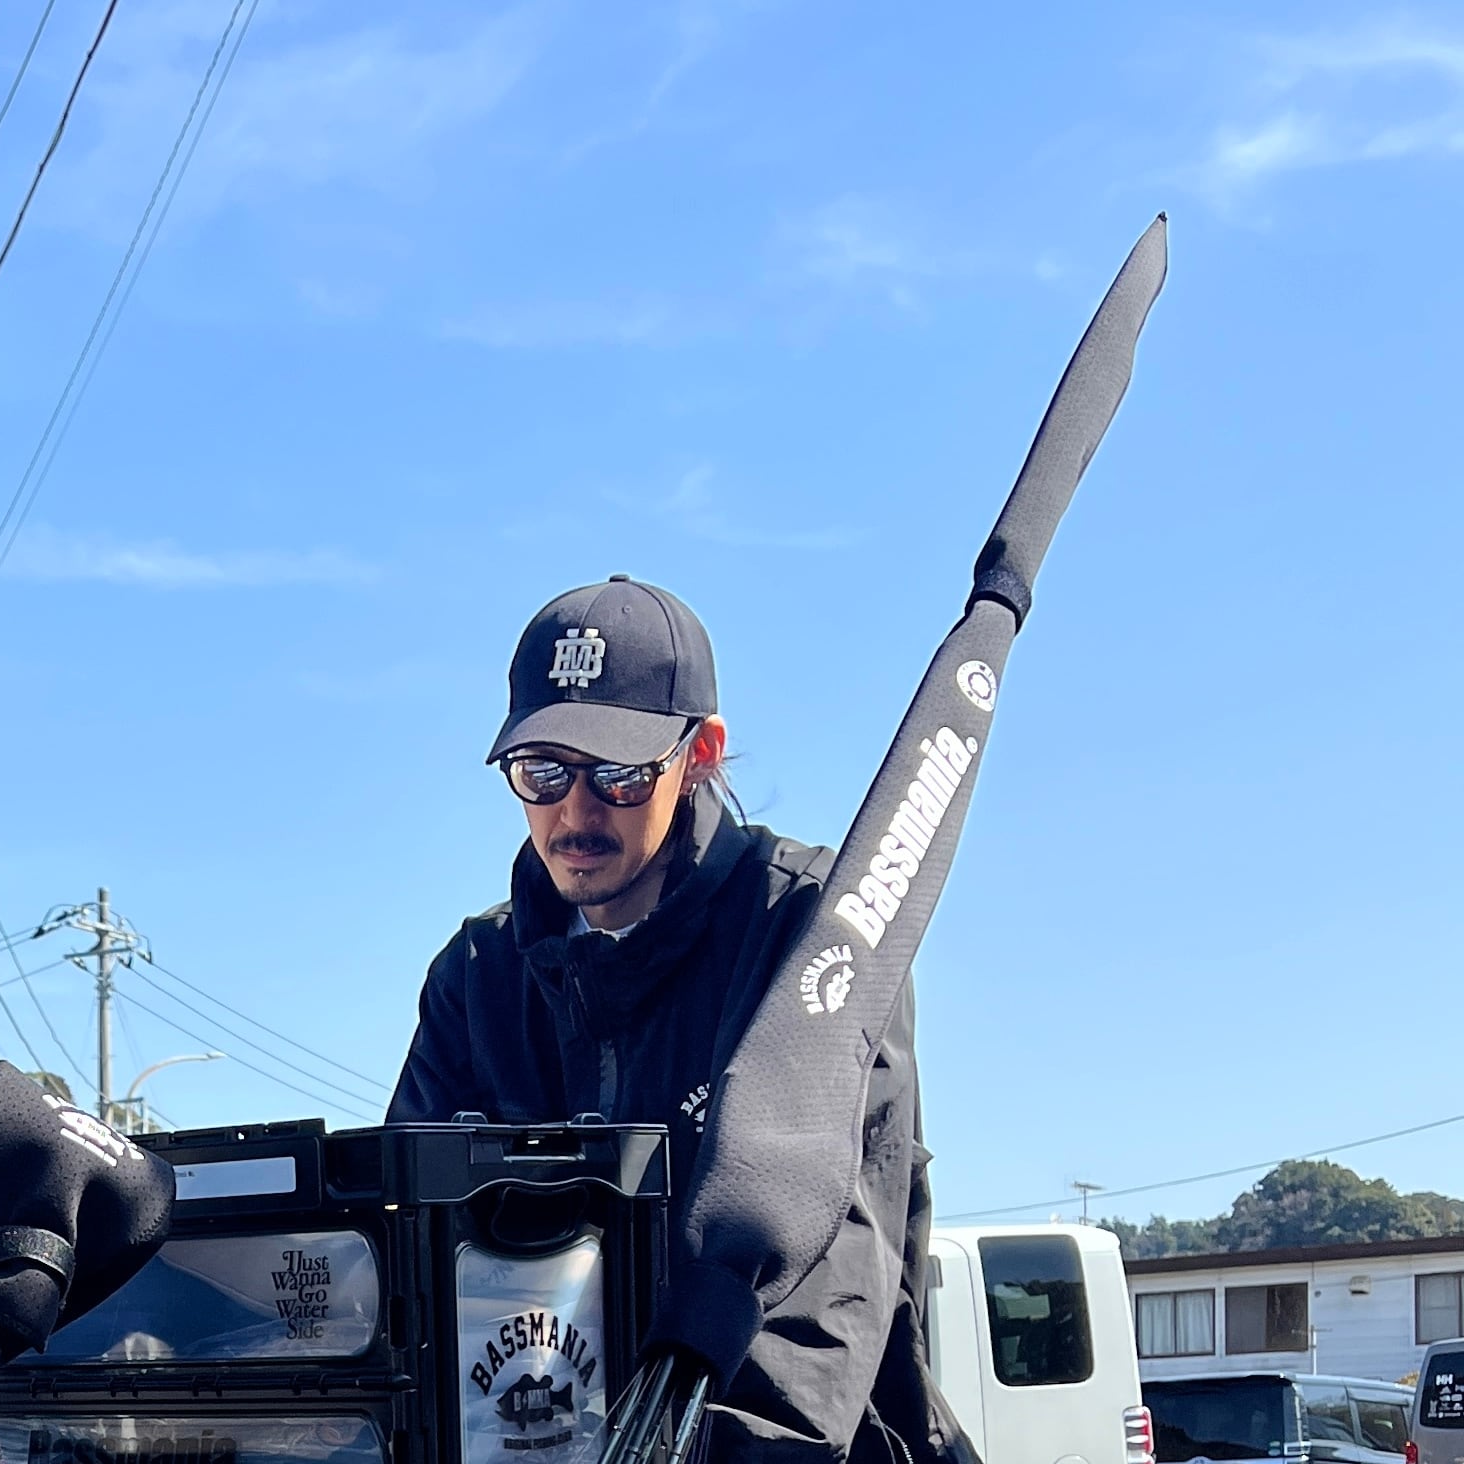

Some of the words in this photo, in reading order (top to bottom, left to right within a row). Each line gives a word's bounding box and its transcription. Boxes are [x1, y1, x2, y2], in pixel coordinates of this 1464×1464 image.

[298, 1284, 327, 1303] Go
[275, 1299, 329, 1319] Water
[286, 1317, 324, 1340] Side
[471, 1313, 597, 1397] BASSMANIA
